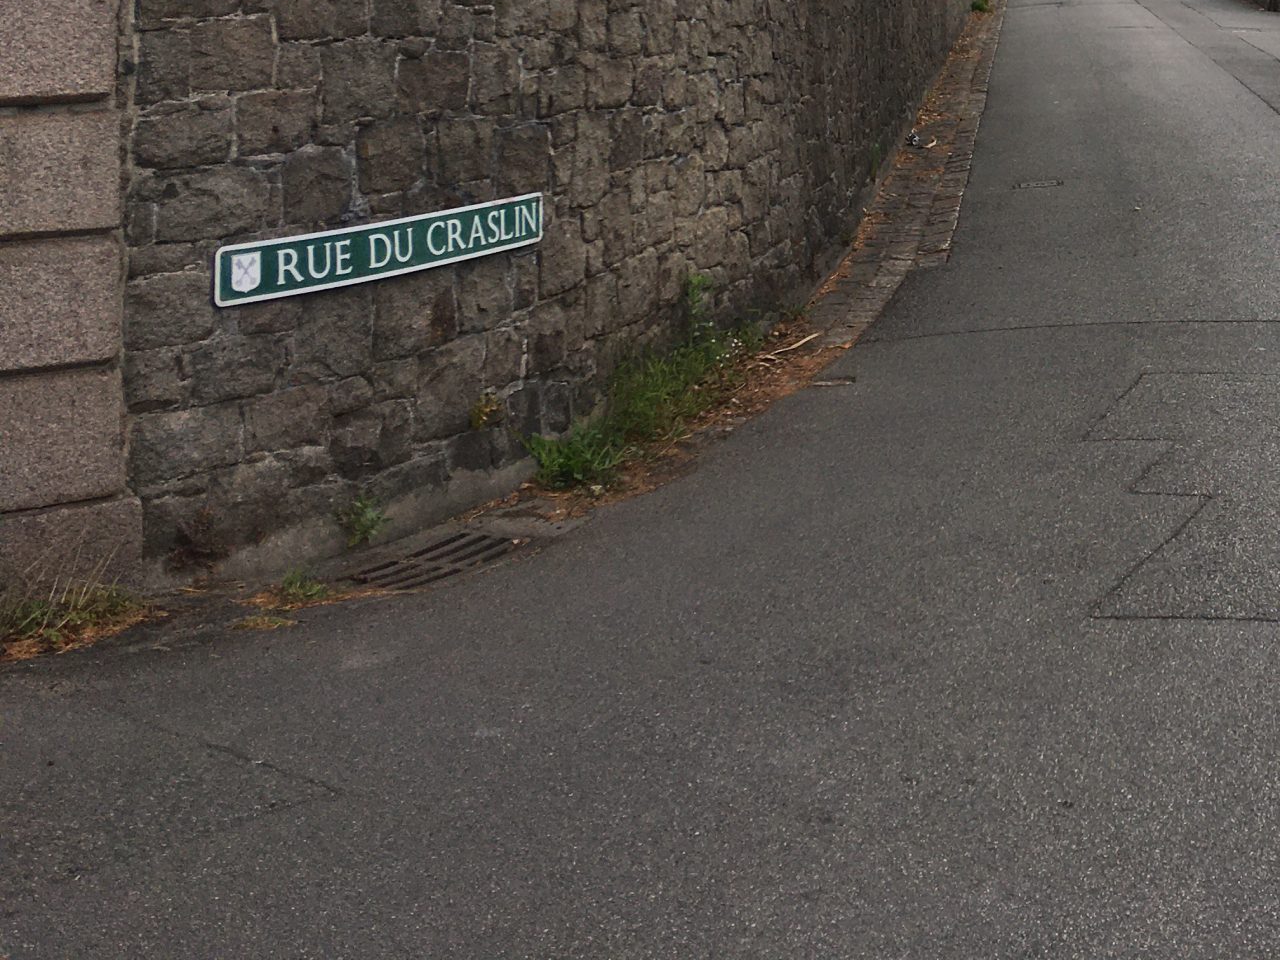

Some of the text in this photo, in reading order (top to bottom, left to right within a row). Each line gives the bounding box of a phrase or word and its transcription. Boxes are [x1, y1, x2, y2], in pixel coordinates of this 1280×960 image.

[277, 202, 538, 285] RUE DU CRASLIN
